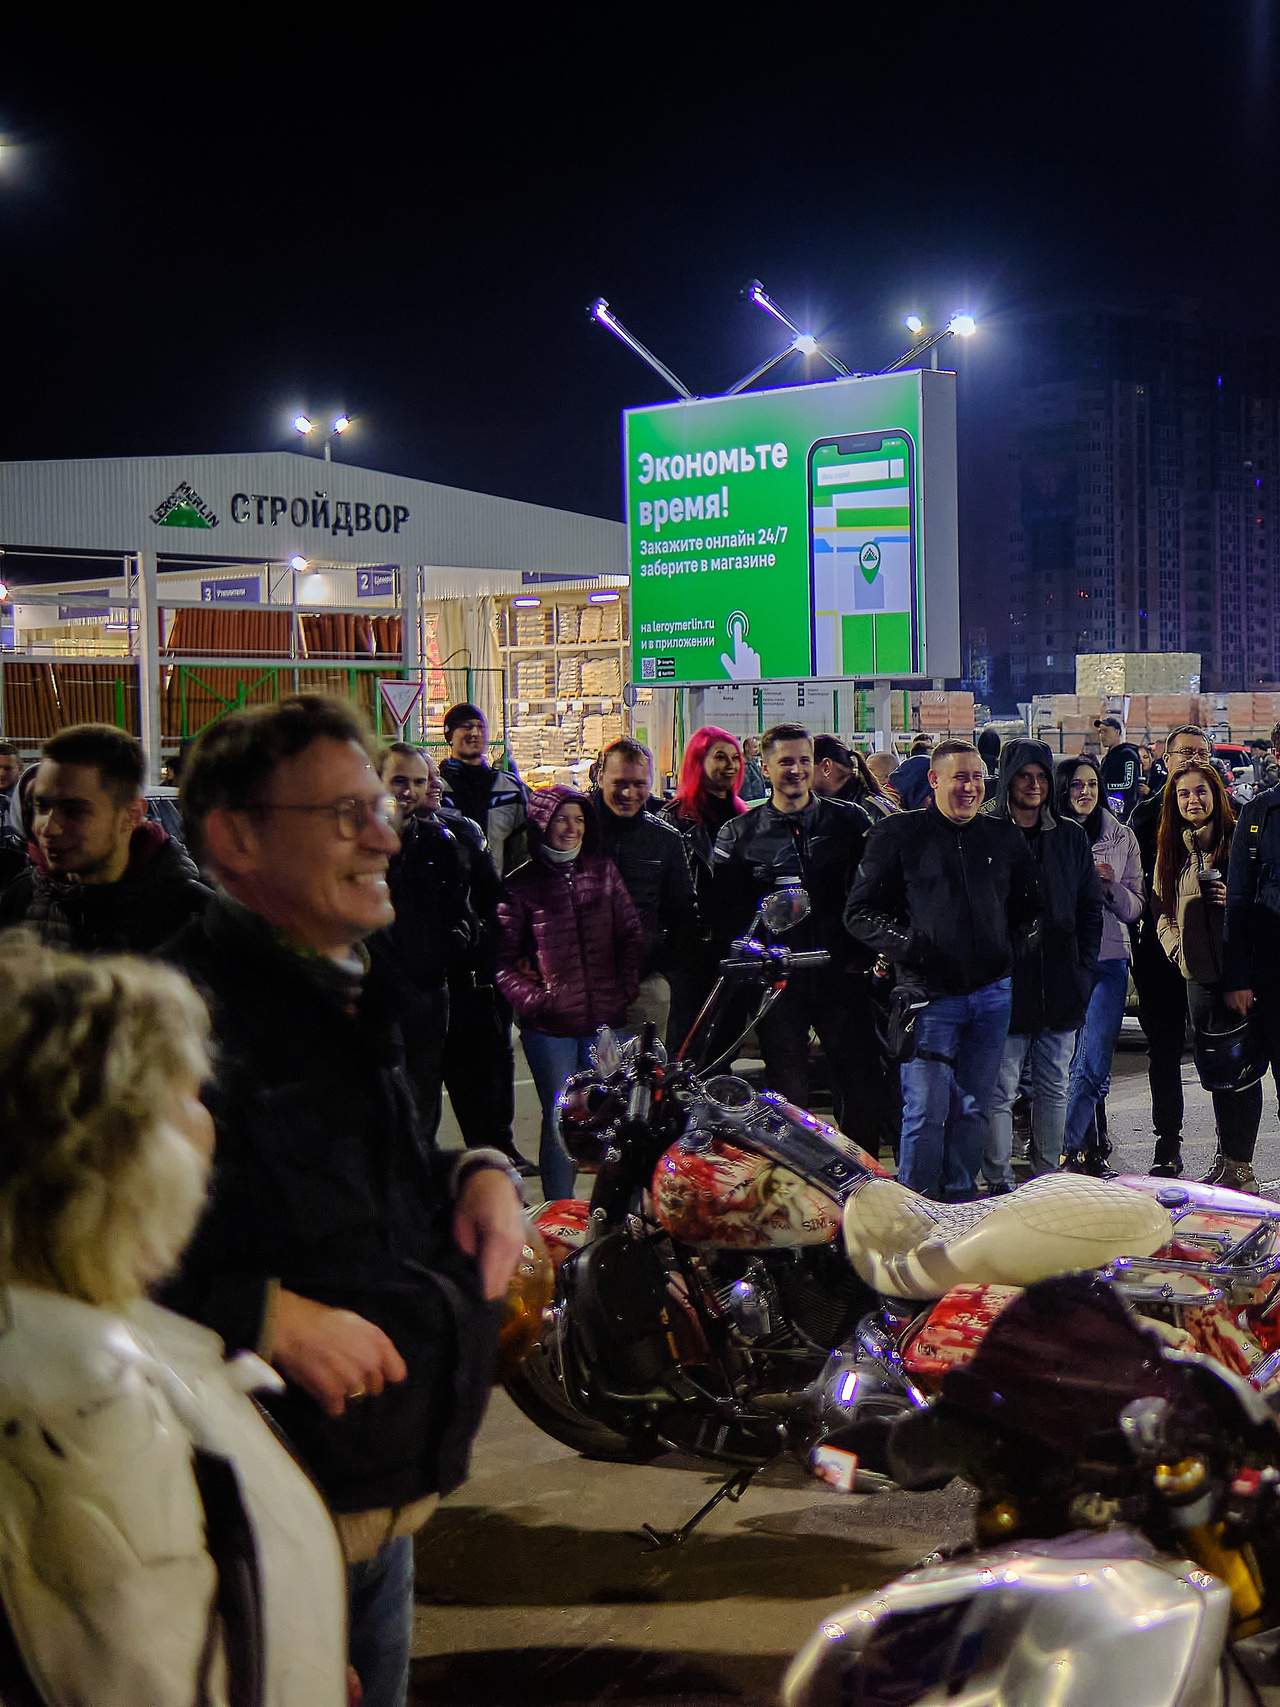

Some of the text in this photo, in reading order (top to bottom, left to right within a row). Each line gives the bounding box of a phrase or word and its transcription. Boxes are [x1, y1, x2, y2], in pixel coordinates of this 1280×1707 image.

[638, 442, 788, 484] Экономьте
[175, 481, 220, 528] MERLIN
[231, 491, 411, 536] СТРОЙДВОР
[638, 486, 729, 533] время!
[640, 526, 788, 555] Закажите онлайн 24/7
[640, 553, 776, 578] заберите в магазине
[205, 587, 212, 602] 3
[361, 574, 369, 591] 2
[640, 618, 715, 634] на leroymerlin.ru
[641, 637, 715, 651] и в приложении
